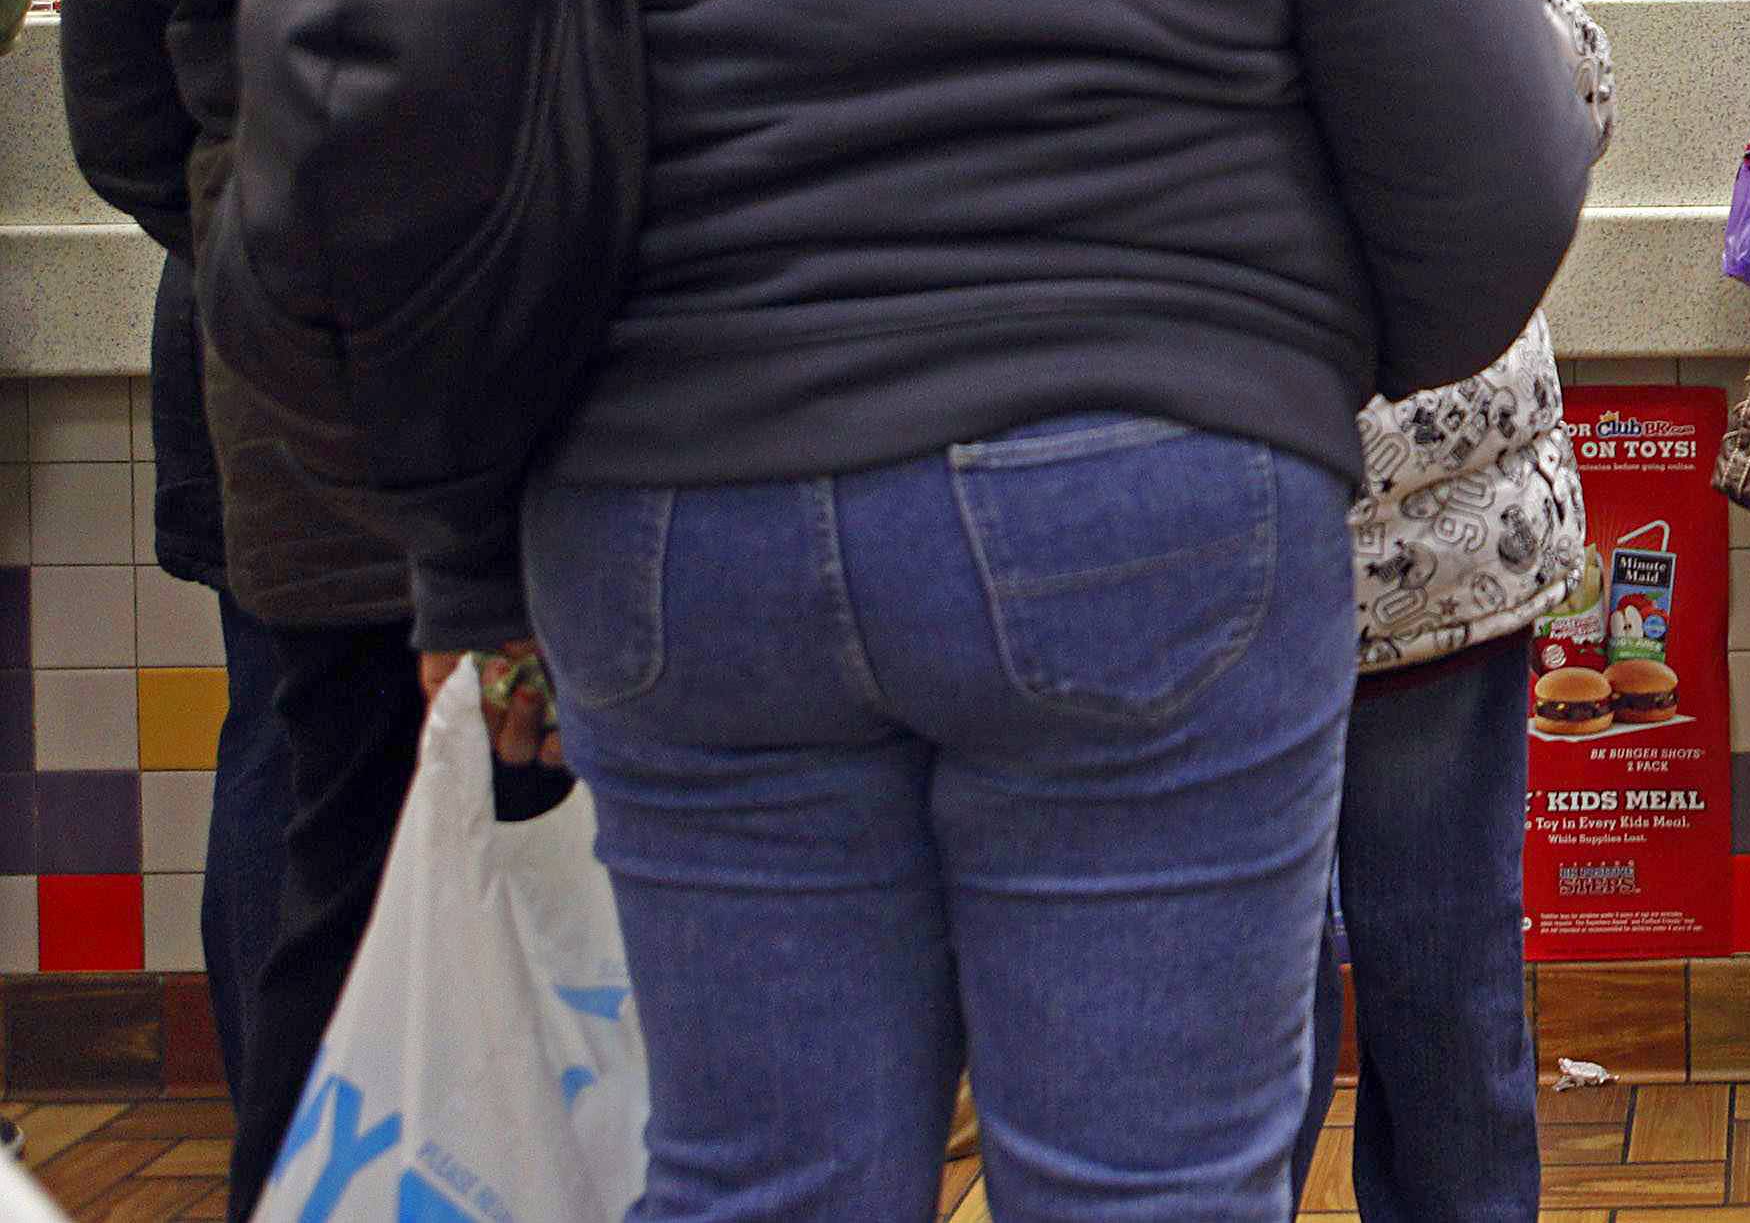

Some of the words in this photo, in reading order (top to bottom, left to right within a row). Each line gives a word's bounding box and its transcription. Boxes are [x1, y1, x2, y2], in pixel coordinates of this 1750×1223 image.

[1567, 423, 1591, 436] OR
[1581, 441, 1616, 458] ON
[1624, 440, 1697, 458] TOYS!
[1619, 555, 1668, 571] Minute
[1624, 570, 1660, 584] Maid
[1609, 748, 1658, 760] BURGER
[1661, 748, 1702, 759] SHOTS
[1637, 761, 1668, 772] PACK
[1547, 790, 1618, 811] KIDS
[1625, 790, 1705, 810] MEAL
[1536, 817, 1559, 831] Toy
[1563, 817, 1575, 829] in
[1579, 817, 1617, 830] Every
[1620, 816, 1650, 828] Kids
[1653, 815, 1690, 827] Meal.
[1548, 834, 1577, 844] While
[1579, 834, 1622, 846] Supplies
